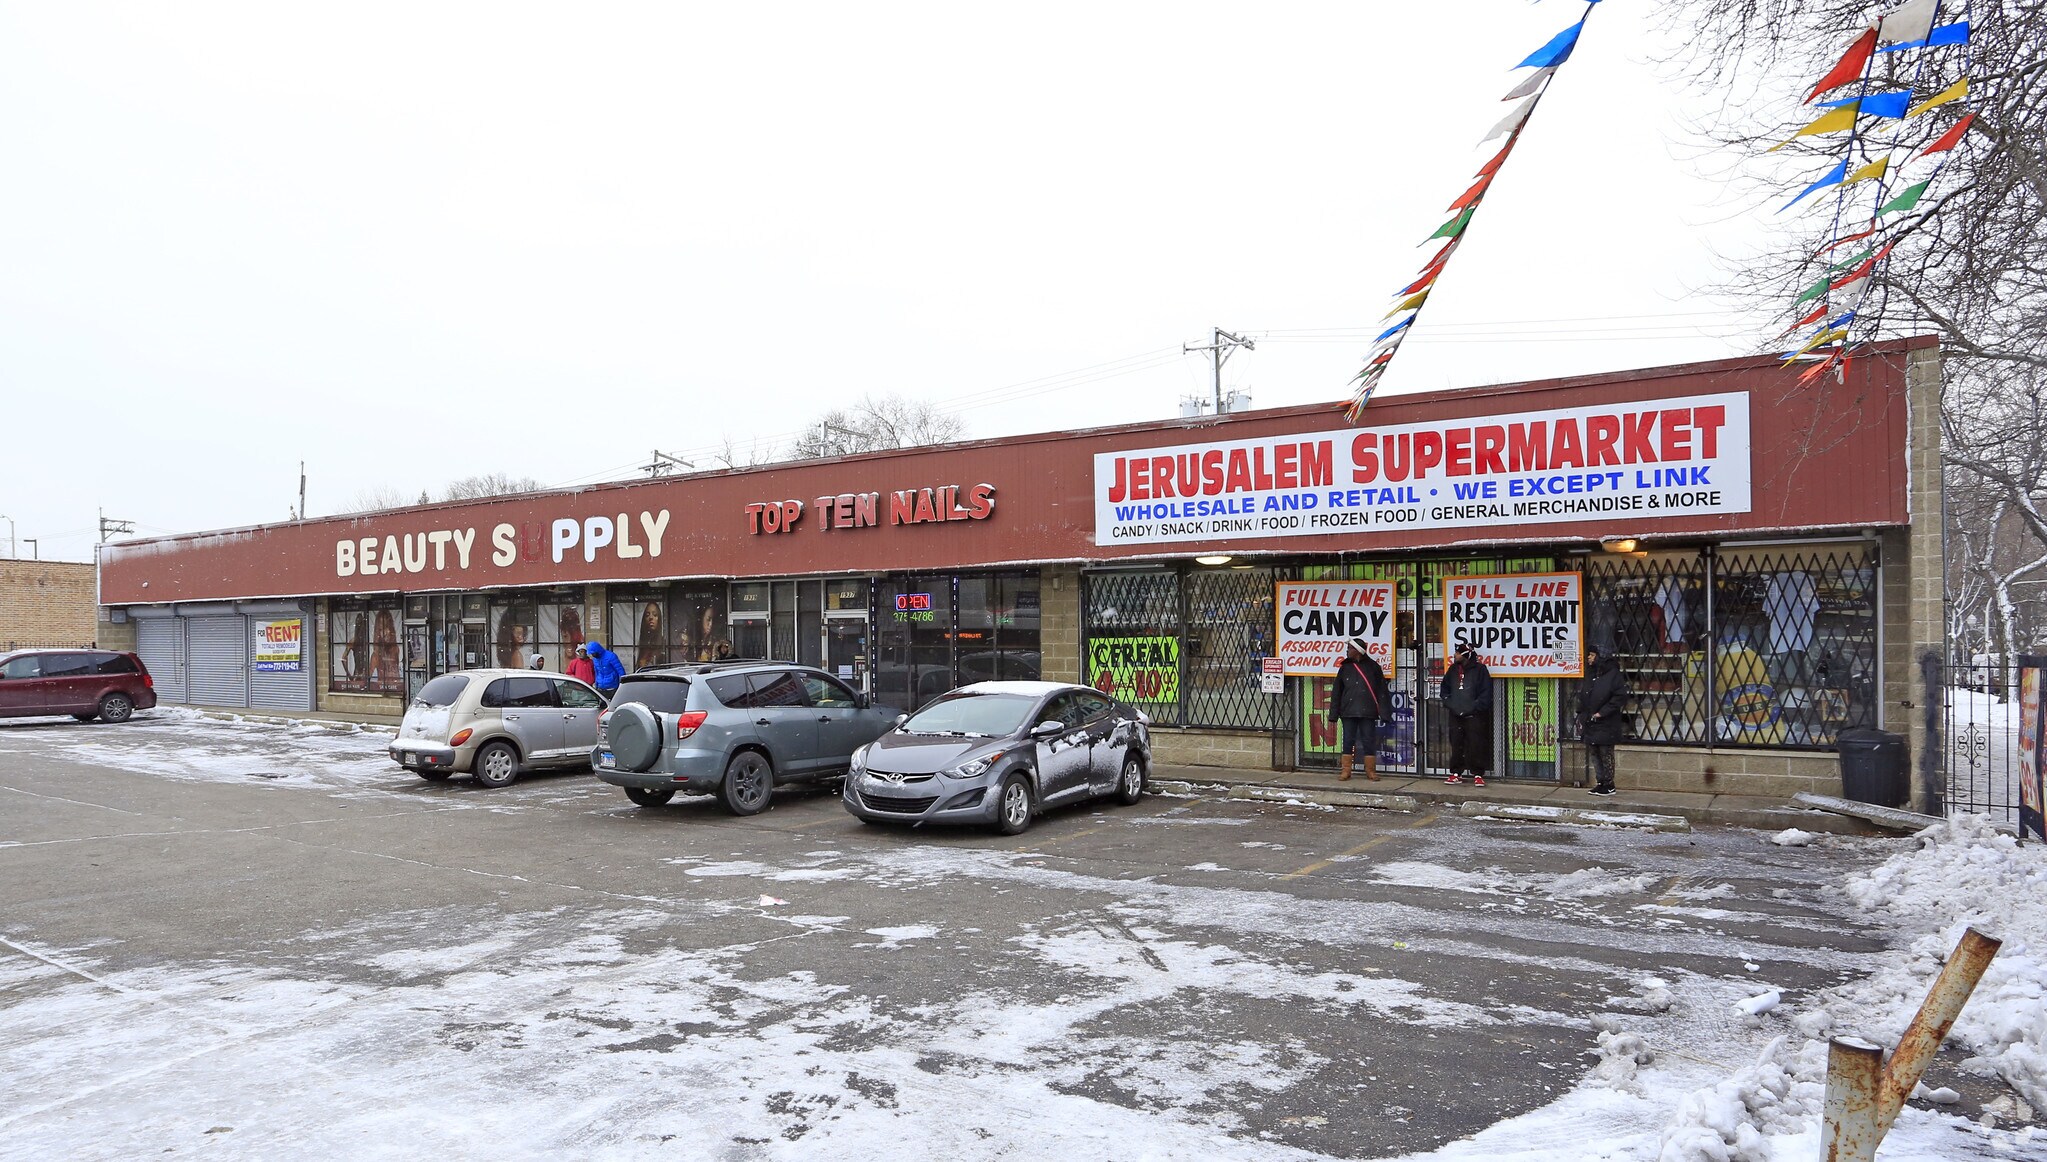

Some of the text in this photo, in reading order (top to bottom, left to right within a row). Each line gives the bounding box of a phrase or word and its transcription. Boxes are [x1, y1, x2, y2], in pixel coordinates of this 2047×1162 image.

[1109, 405, 1725, 503] JERUSALEM SUPERMARKET
[1115, 465, 1711, 522] WHOLESALE AND RETAIL WE EXCEPT LINK
[745, 482, 996, 536] TOP TEN NAILS
[1112, 524, 1154, 538] CANDY
[1161, 521, 1204, 535] SNACK
[1212, 518, 1253, 533] DRINK
[1311, 512, 1369, 528] FROZEN
[1375, 508, 1418, 524] FOOD
[1431, 503, 1510, 521] GENERAL
[1513, 495, 1643, 516] MERCHANDISE
[1647, 494, 1661, 509] &
[1665, 490, 1722, 508] MORE
[336, 526, 475, 577] BEAUTY
[897, 596, 929, 609] OPEN
[1285, 588, 1389, 608] FULL LINE
[1453, 582, 1569, 600] FULL LINE
[1283, 609, 1389, 637] CANDY
[1450, 600, 1580, 624] RESTAURANT
[266, 625, 301, 642] RENT
[1095, 643, 1174, 668] CEREAL
[1281, 640, 1345, 653] ASSORTED
[1286, 656, 1330, 668] CANDY
[1524, 704, 1543, 721] TO
